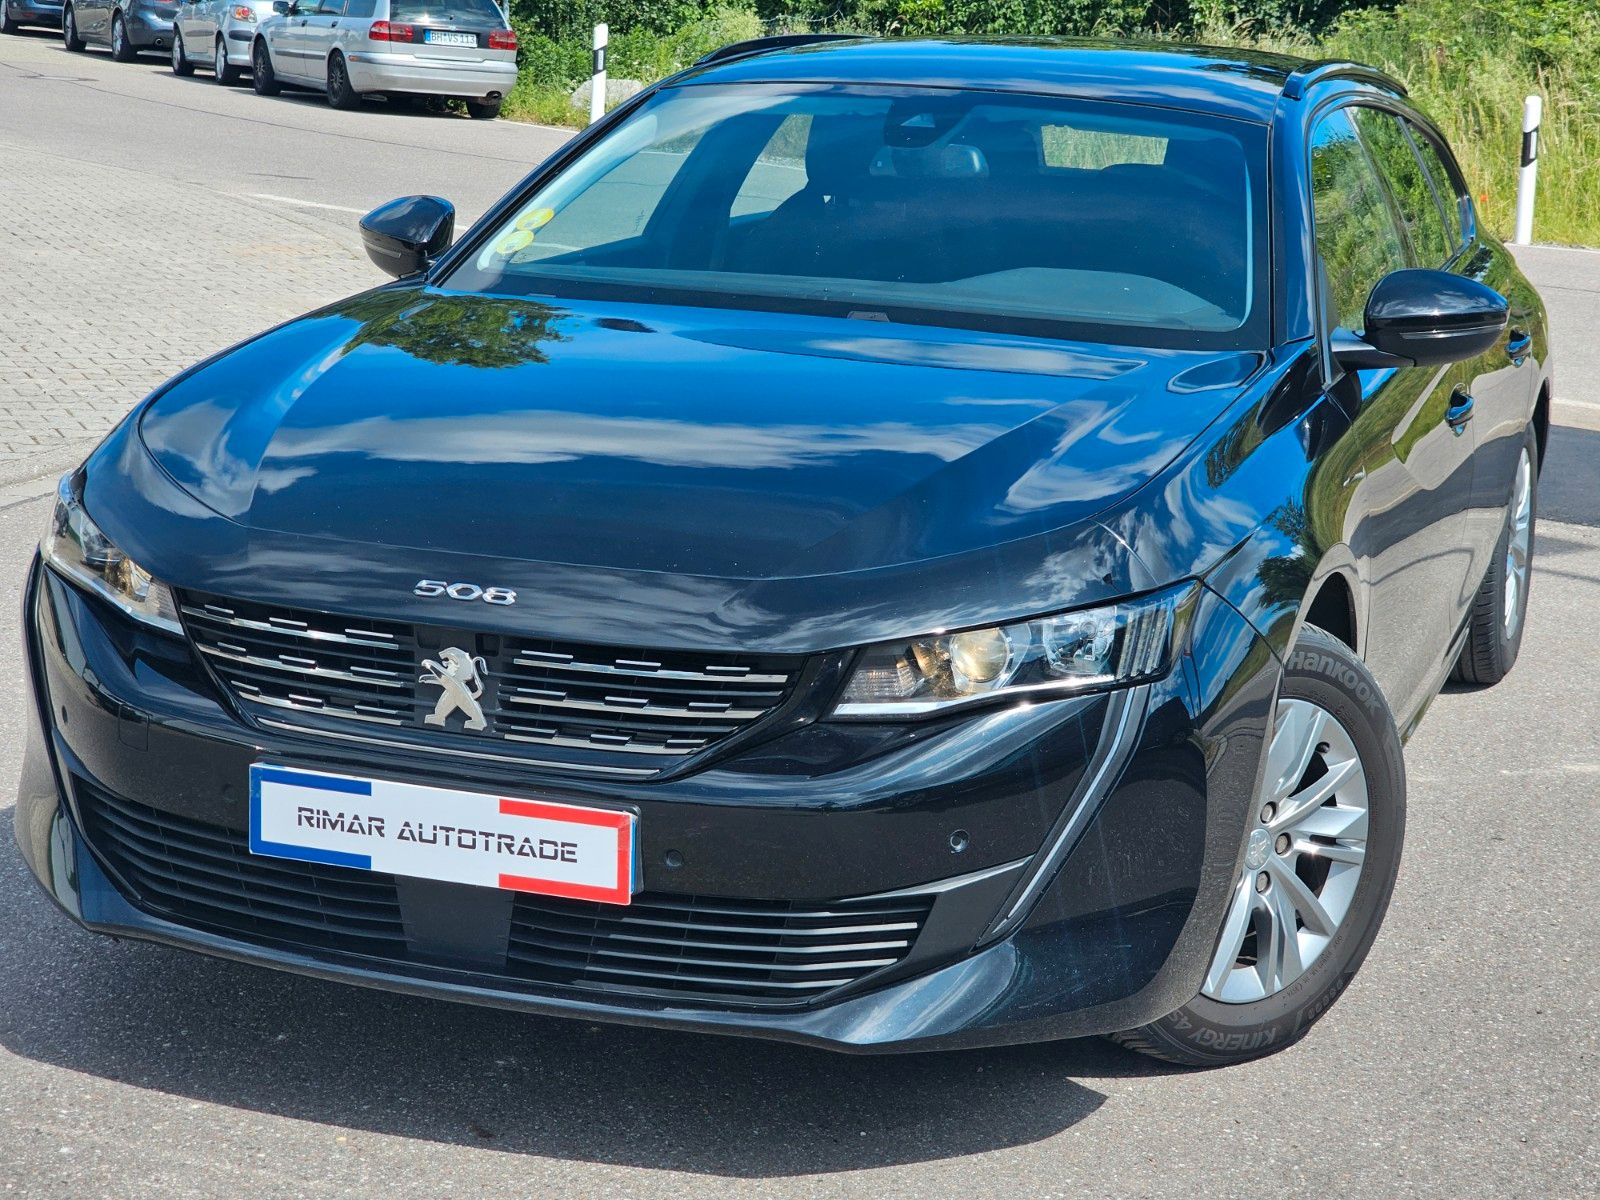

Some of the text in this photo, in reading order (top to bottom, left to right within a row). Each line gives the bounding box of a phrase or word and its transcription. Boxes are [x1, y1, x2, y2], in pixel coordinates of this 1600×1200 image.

[413, 579, 517, 606] 508
[297, 806, 578, 864] RIMAR AUTOTRADE
